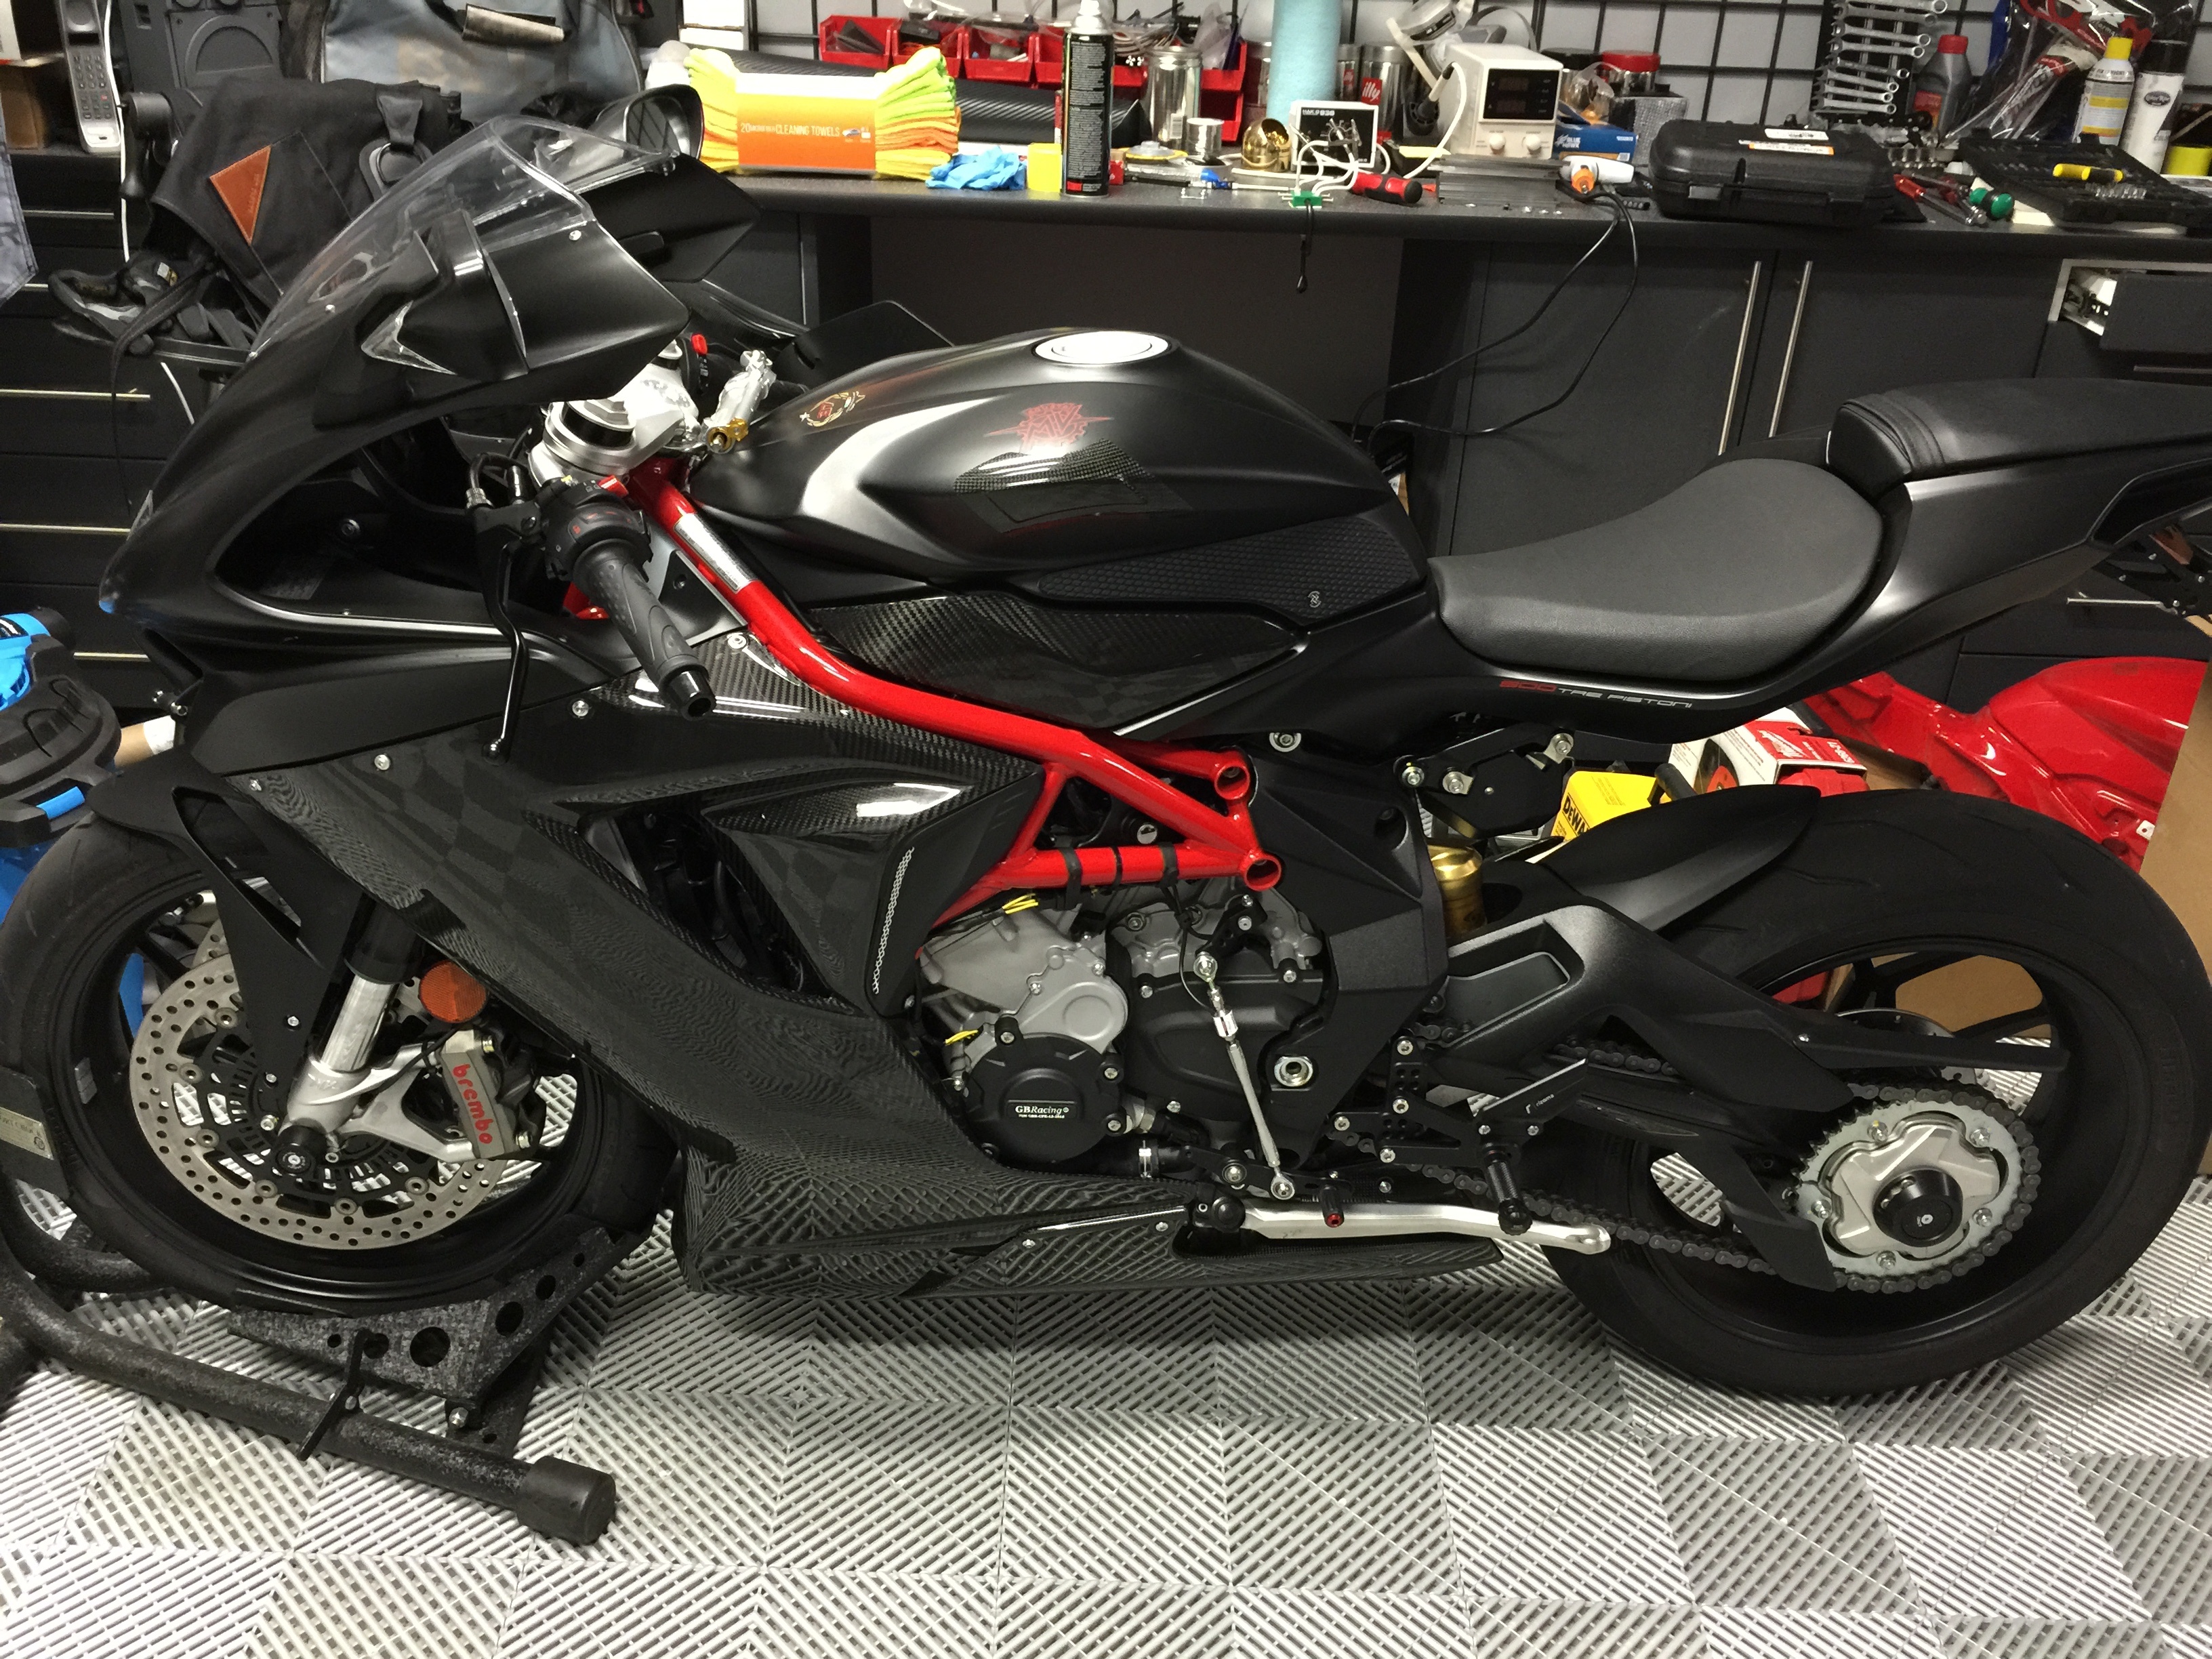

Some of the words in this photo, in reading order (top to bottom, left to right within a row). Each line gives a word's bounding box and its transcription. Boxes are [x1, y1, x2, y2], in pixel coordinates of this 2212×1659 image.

[1362, 81, 1380, 102] illy
[775, 124, 809, 136] CLEANING
[812, 125, 840, 137] TOWELS
[1559, 688, 1603, 699] TRE
[1607, 694, 1692, 709] PISTONI
[1562, 795, 1590, 834] DEWA
[453, 1063, 493, 1144] brembo
[1015, 1105, 1063, 1115] GBRacing
